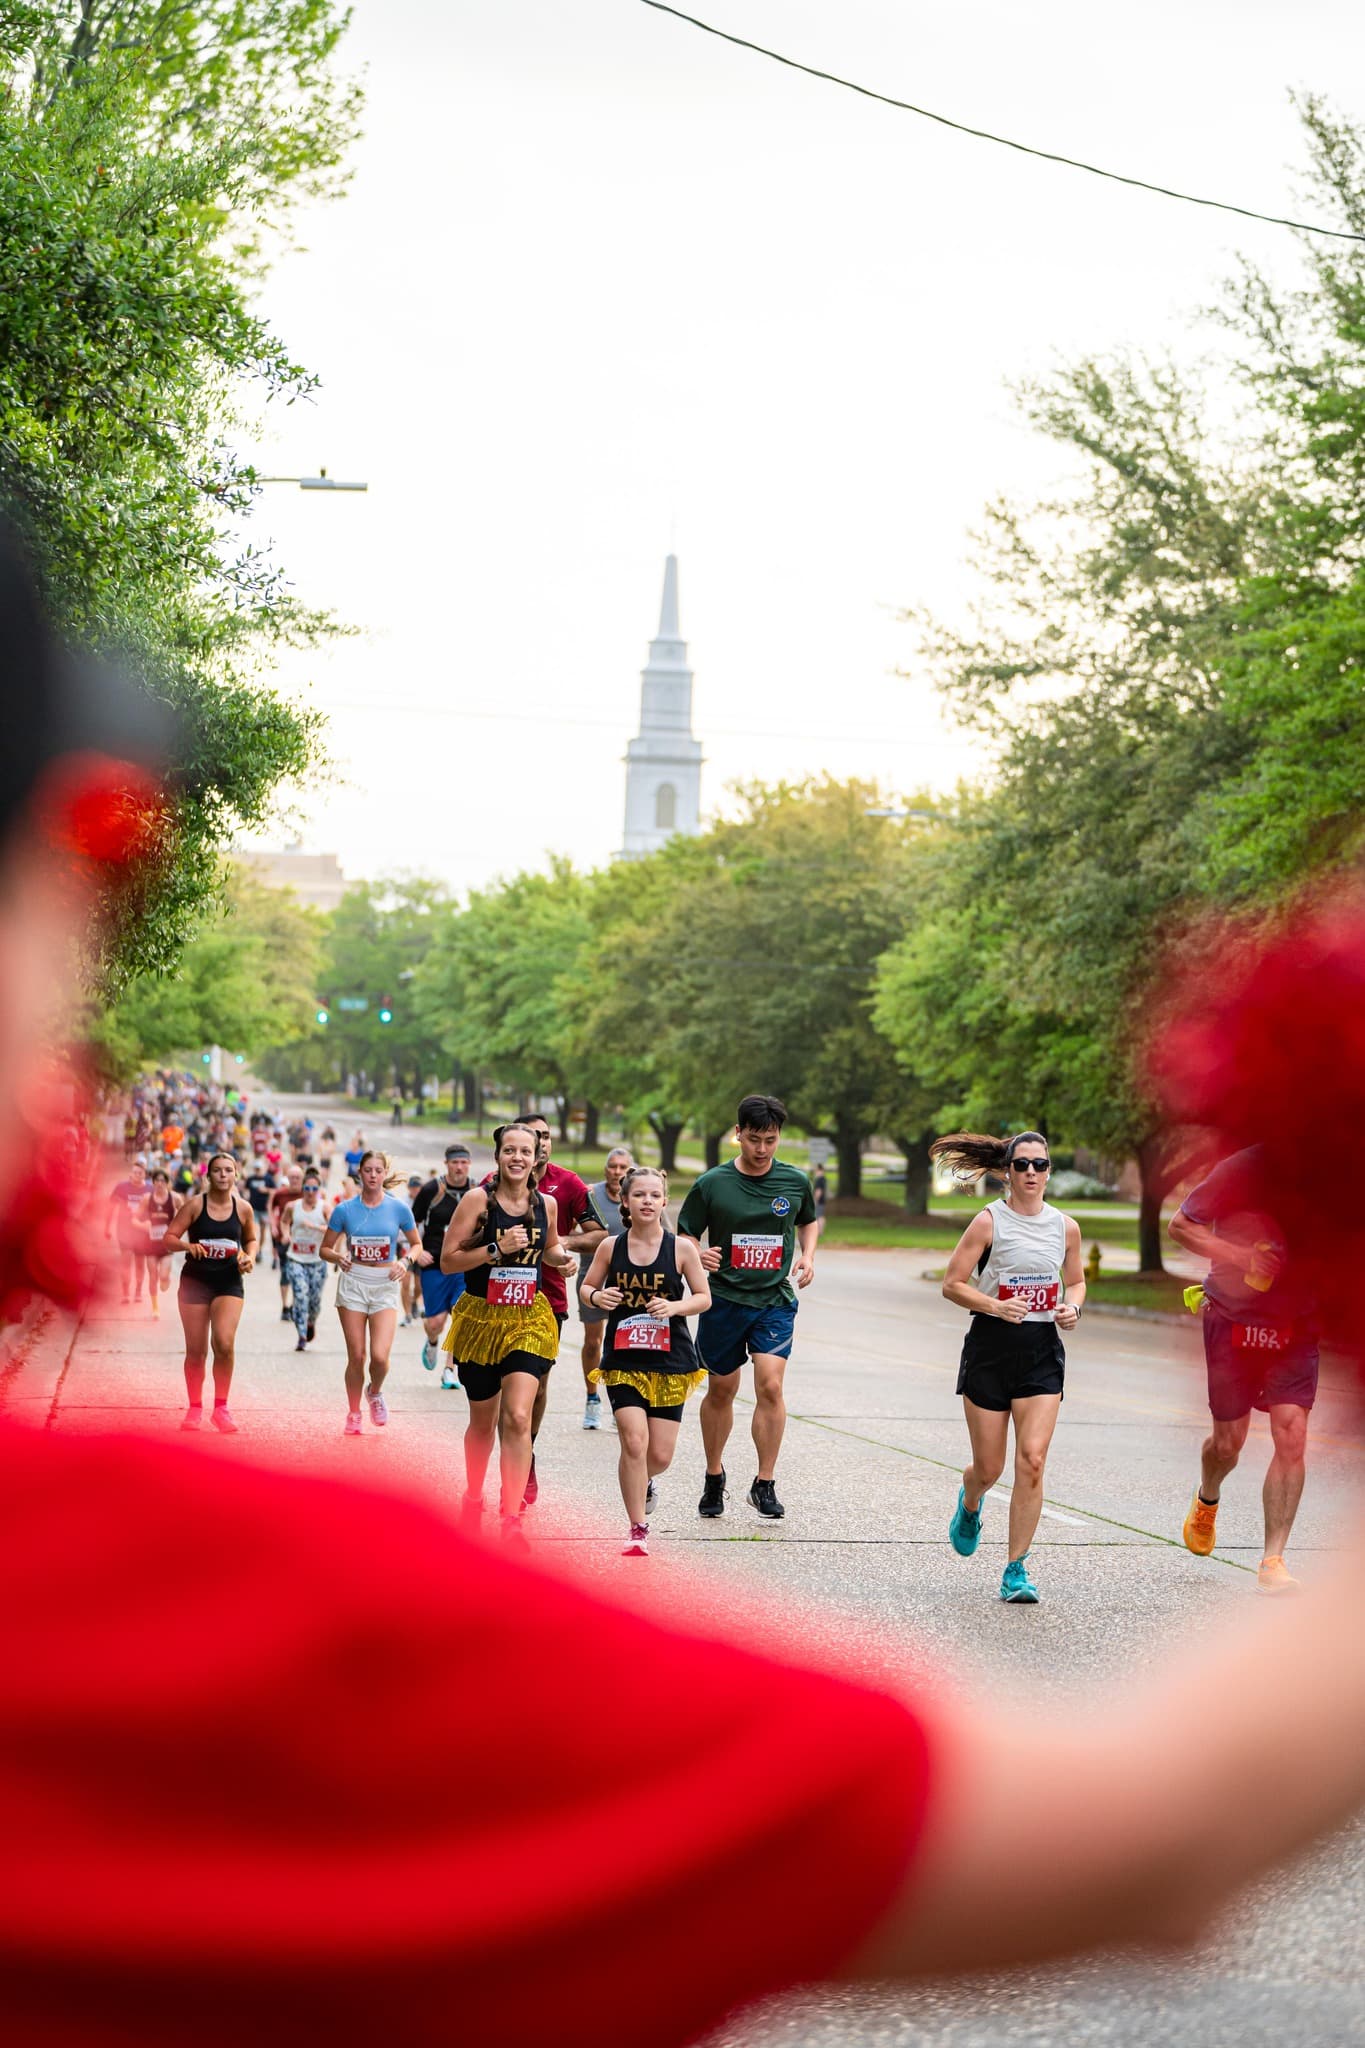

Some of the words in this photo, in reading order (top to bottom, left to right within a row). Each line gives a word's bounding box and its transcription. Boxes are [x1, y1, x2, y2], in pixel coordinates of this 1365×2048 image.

[497, 1228, 541, 1245] HF
[360, 1247, 382, 1258] 306
[744, 1249, 772, 1264] 1197
[616, 1272, 664, 1290] HALF
[503, 1284, 528, 1300] 461
[629, 1329, 657, 1343] 457
[1245, 1326, 1278, 1344] 1162
